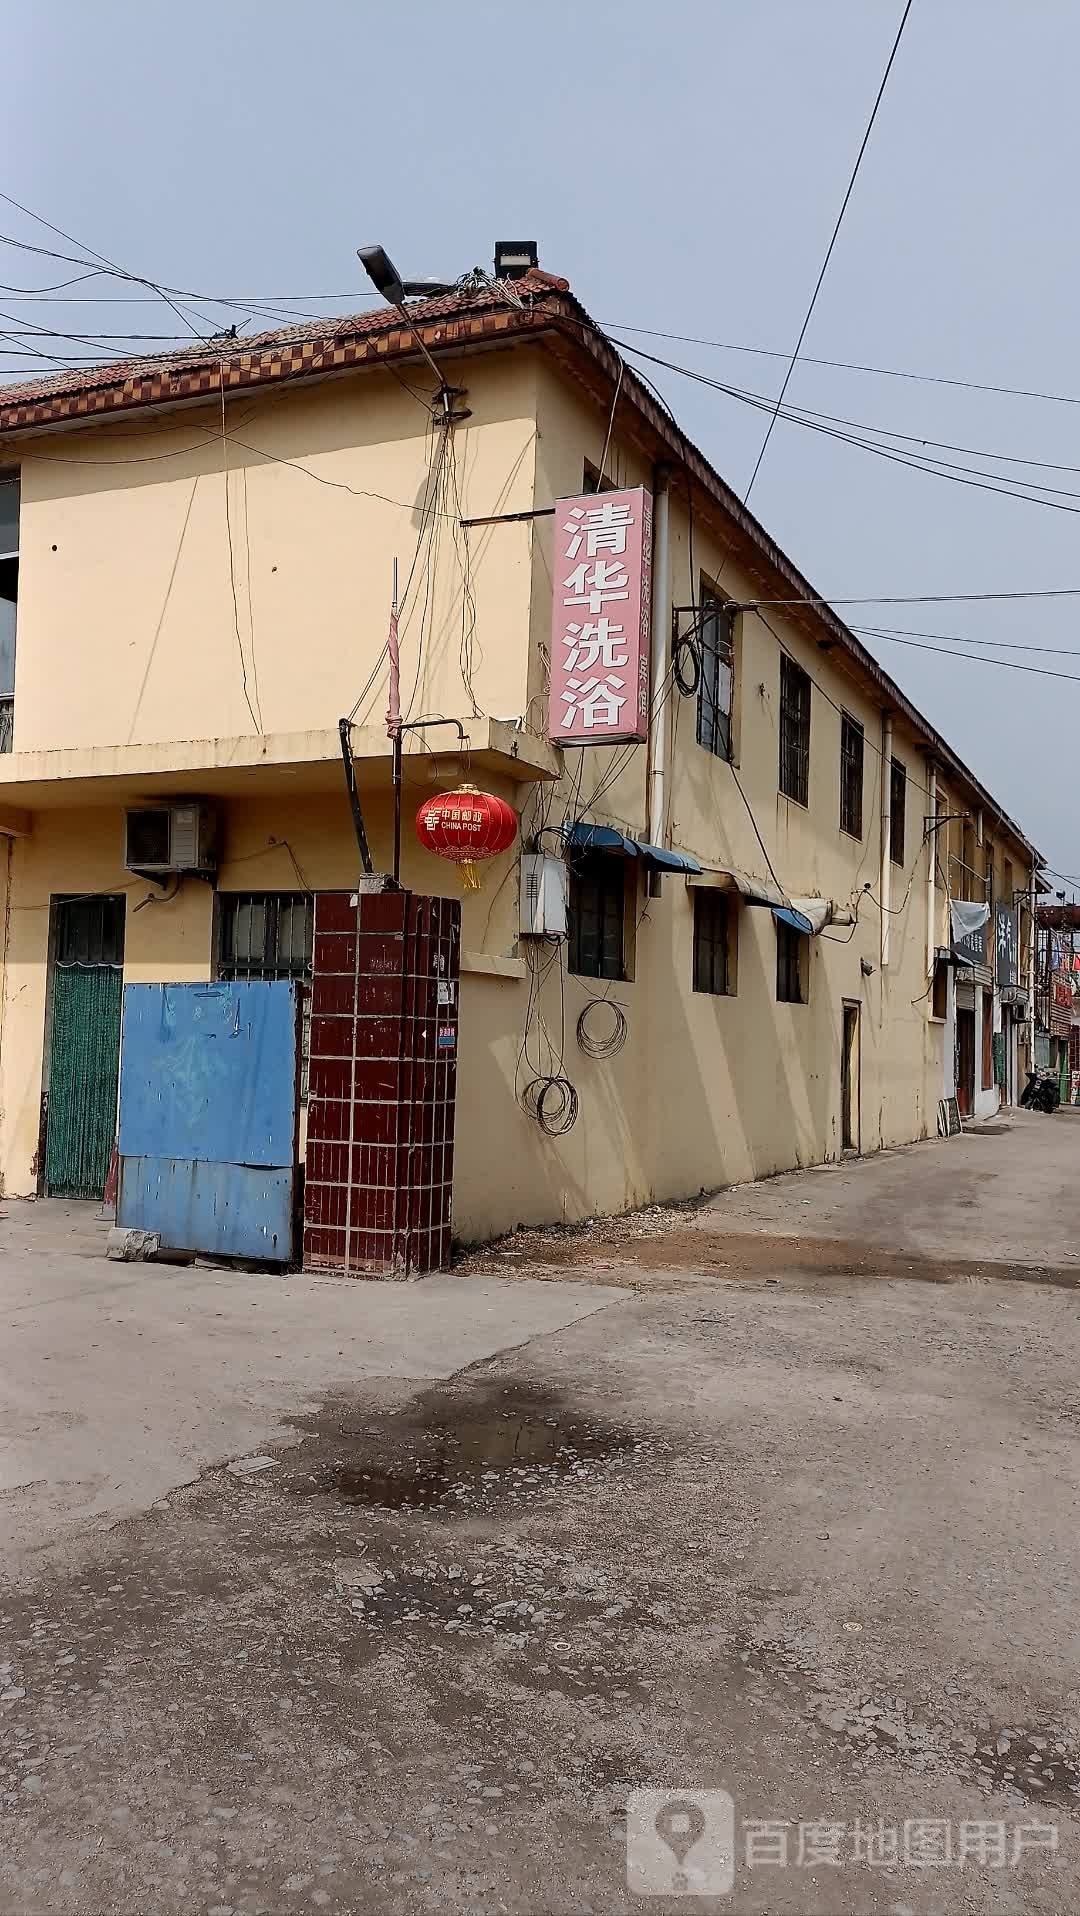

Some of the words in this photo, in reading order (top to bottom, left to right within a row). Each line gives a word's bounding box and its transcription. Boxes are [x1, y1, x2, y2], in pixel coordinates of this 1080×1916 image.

[561, 503, 634, 728] 清华洗浴
[441, 808, 482, 823] 中国邮政
[441, 821, 462, 830] CHINA
[462, 823, 482, 831] POST
